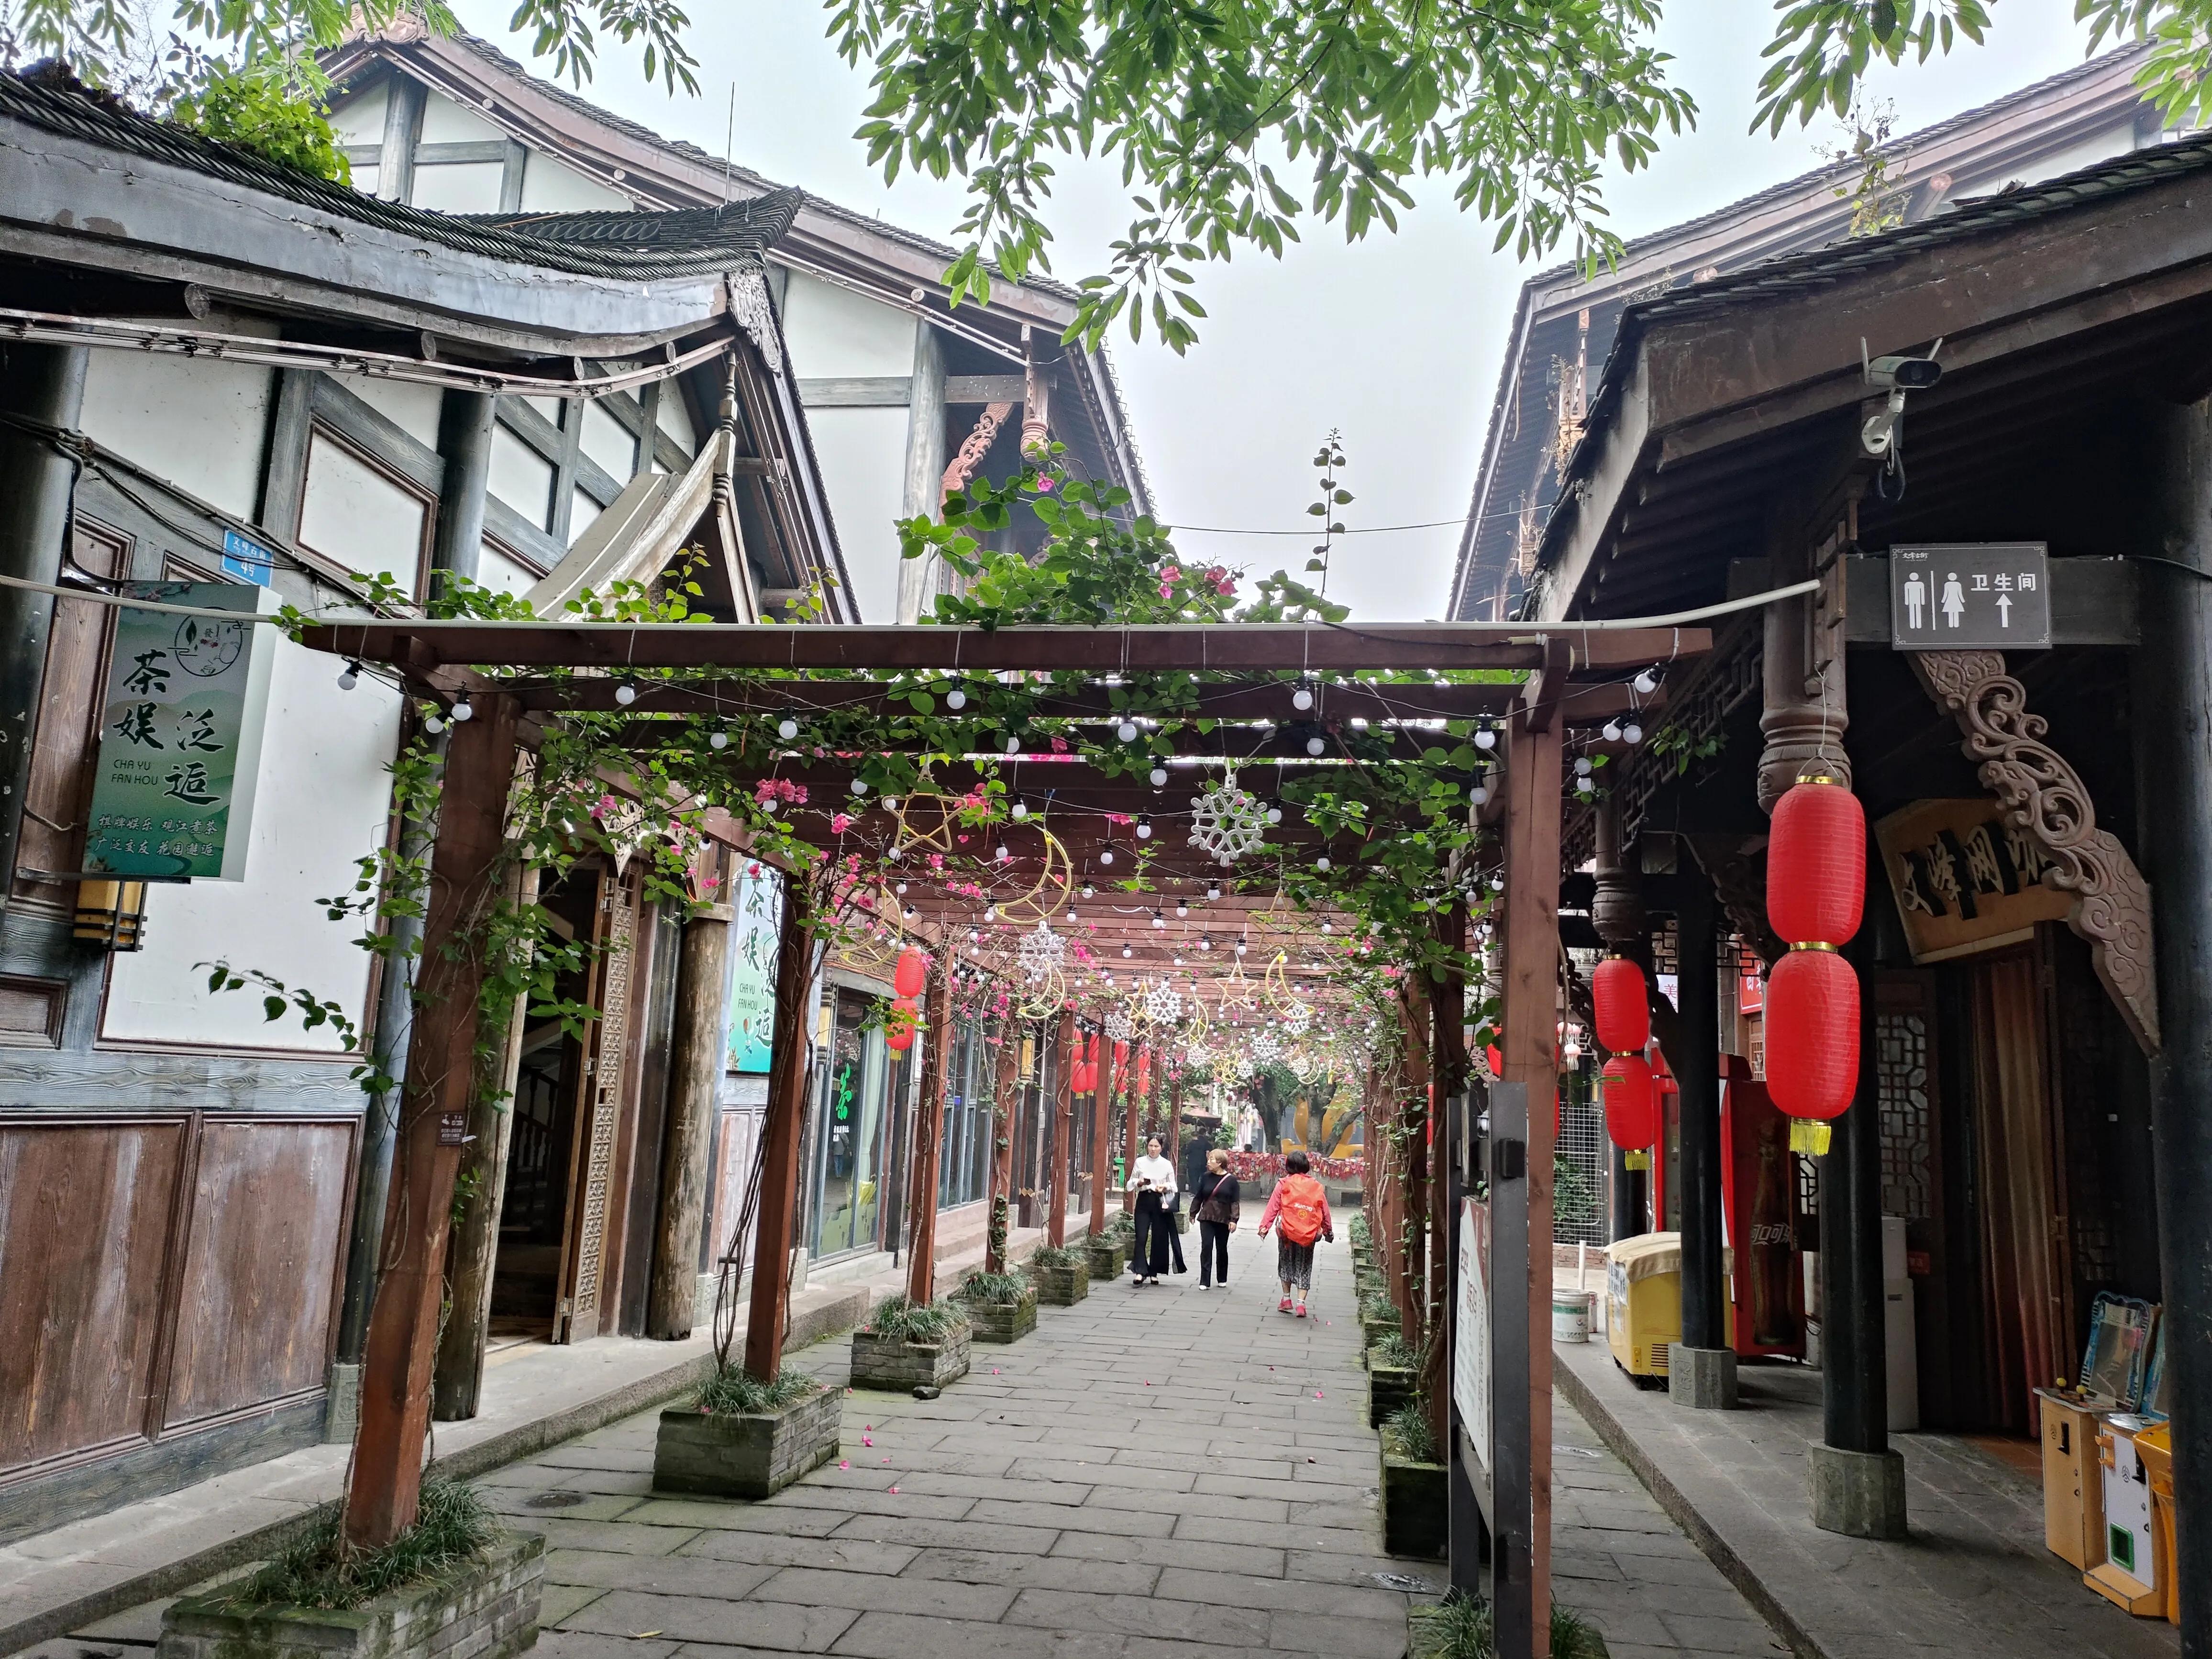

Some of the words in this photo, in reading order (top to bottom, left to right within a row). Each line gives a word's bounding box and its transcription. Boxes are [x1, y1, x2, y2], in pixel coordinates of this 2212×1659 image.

[1970, 573, 2036, 591] 卫生间
[112, 649, 171, 750] 茶娱
[113, 759, 134, 770] CHA
[137, 761, 151, 771] YU
[164, 708, 225, 805] 泛逅
[111, 774, 131, 784] FAN
[134, 775, 158, 786] HOU
[98, 814, 153, 831] 棋牌娱乐
[161, 819, 218, 835] 观江煮茶
[94, 836, 150, 855] 广泛交友
[156, 841, 215, 856] 花园邂逅
[739, 983, 749, 994] CHA
[749, 984, 755, 995] YU
[738, 998, 747, 1009] FAN
[747, 999, 758, 1010] HOU
